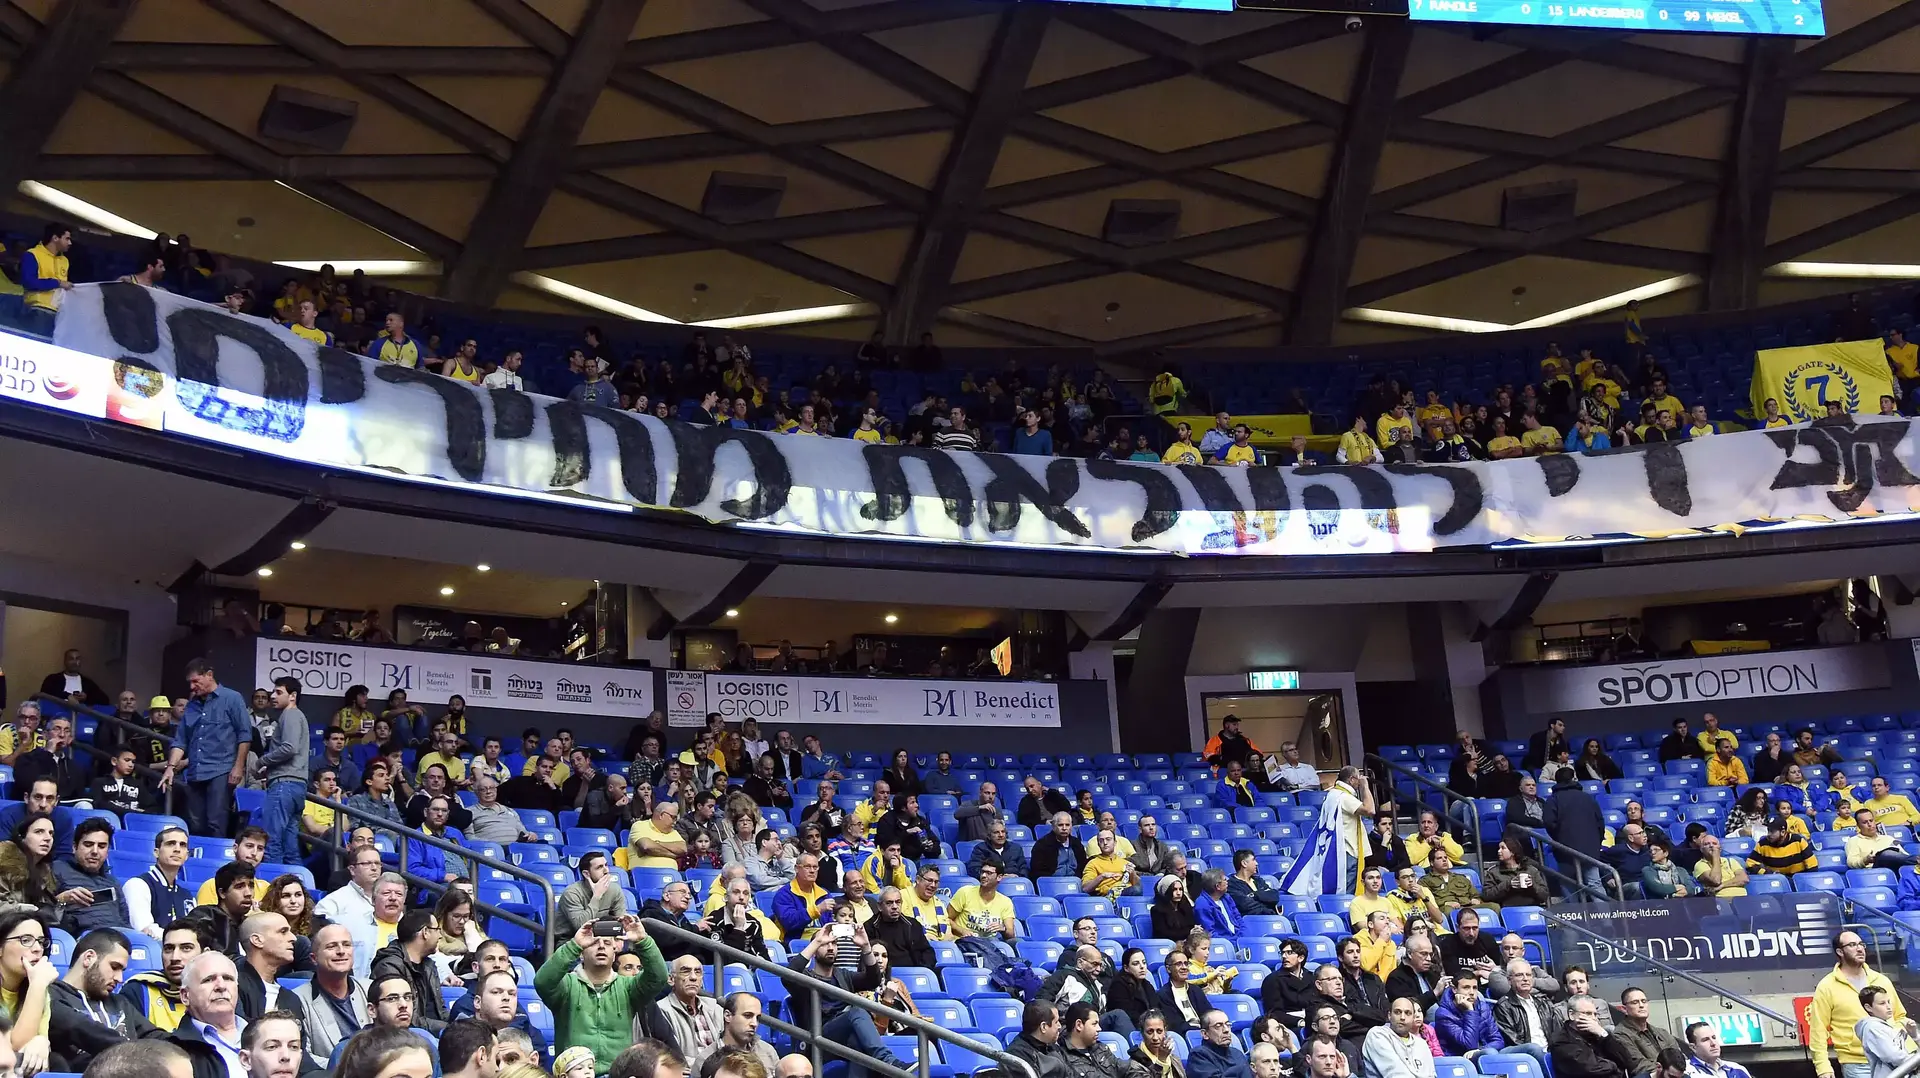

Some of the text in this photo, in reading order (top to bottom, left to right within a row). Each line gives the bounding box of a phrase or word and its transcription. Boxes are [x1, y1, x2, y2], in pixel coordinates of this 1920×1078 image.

[1521, 4, 1531, 14] 0
[1549, 5, 1563, 16] 15
[1659, 9, 1668, 20] 0
[1684, 10, 1700, 22] 99
[1794, 15, 1804, 25] 2
[1797, 361, 1823, 372] GATE
[1805, 374, 1830, 406] 7
[101, 281, 792, 519] מחירים!
[269, 648, 353, 667] LOGISTIC
[426, 670, 455, 680] Benedict
[668, 671, 684, 679] לעשן
[606, 686, 643, 699] אדמה
[717, 682, 788, 696] LOGISTIC
[1598, 663, 1818, 706] SPOTOPTION
[718, 699, 789, 716] GROUP
[974, 690, 1055, 709] Benedict
[1589, 908, 1670, 920] www.almog-ltd.com
[1577, 929, 1803, 971] אלמוג הבית שלך
